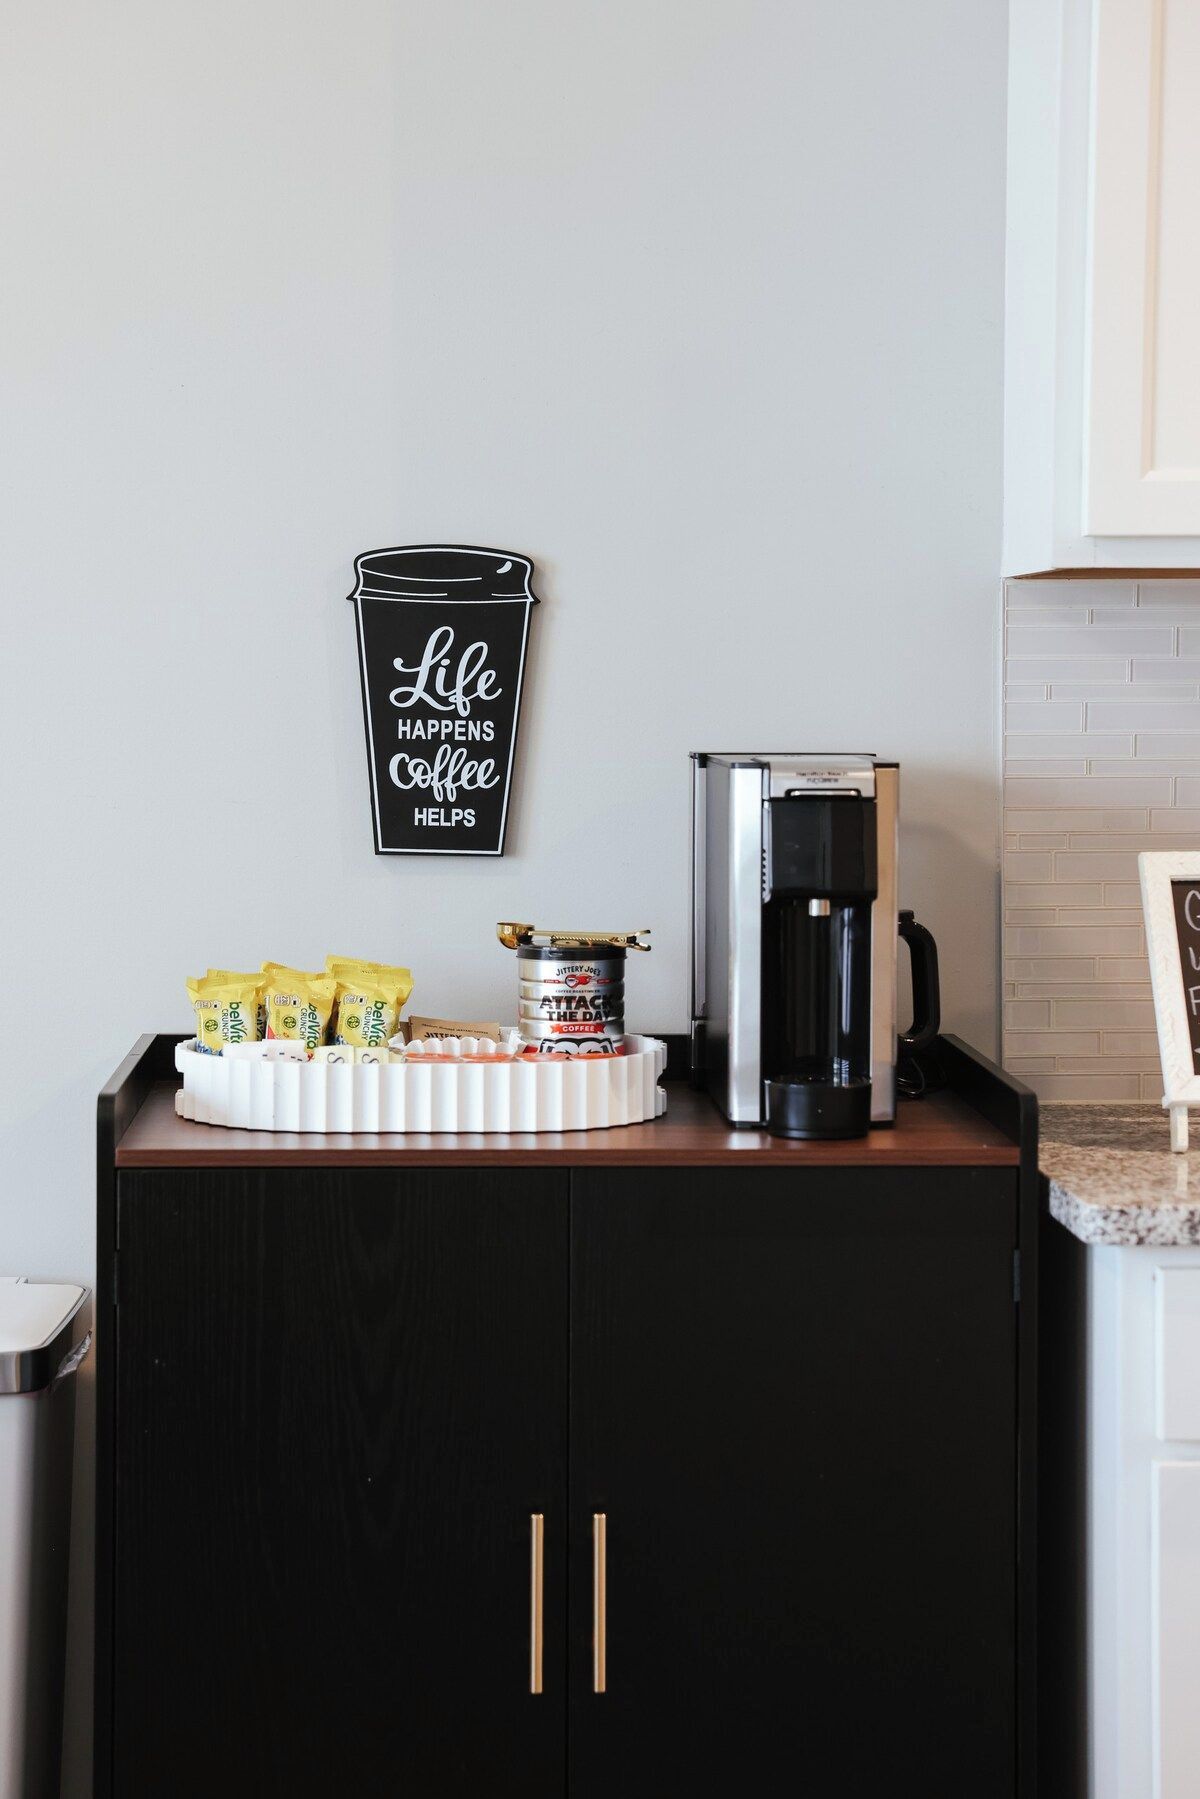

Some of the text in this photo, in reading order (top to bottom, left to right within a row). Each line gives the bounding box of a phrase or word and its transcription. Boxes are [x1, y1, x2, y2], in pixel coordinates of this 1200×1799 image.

[388, 626, 503, 717] Life
[397, 719, 495, 741] HAPPENS
[388, 743, 500, 802] Coffee
[413, 807, 476, 827] HELPS
[555, 965, 601, 977] JITTERY JOE'S
[221, 1009, 230, 1042] CRUNCHY
[299, 1007, 308, 1041] CRUNCHY
[361, 1006, 373, 1041] CRUNCHY
[546, 1010, 610, 1022] THE DAY
